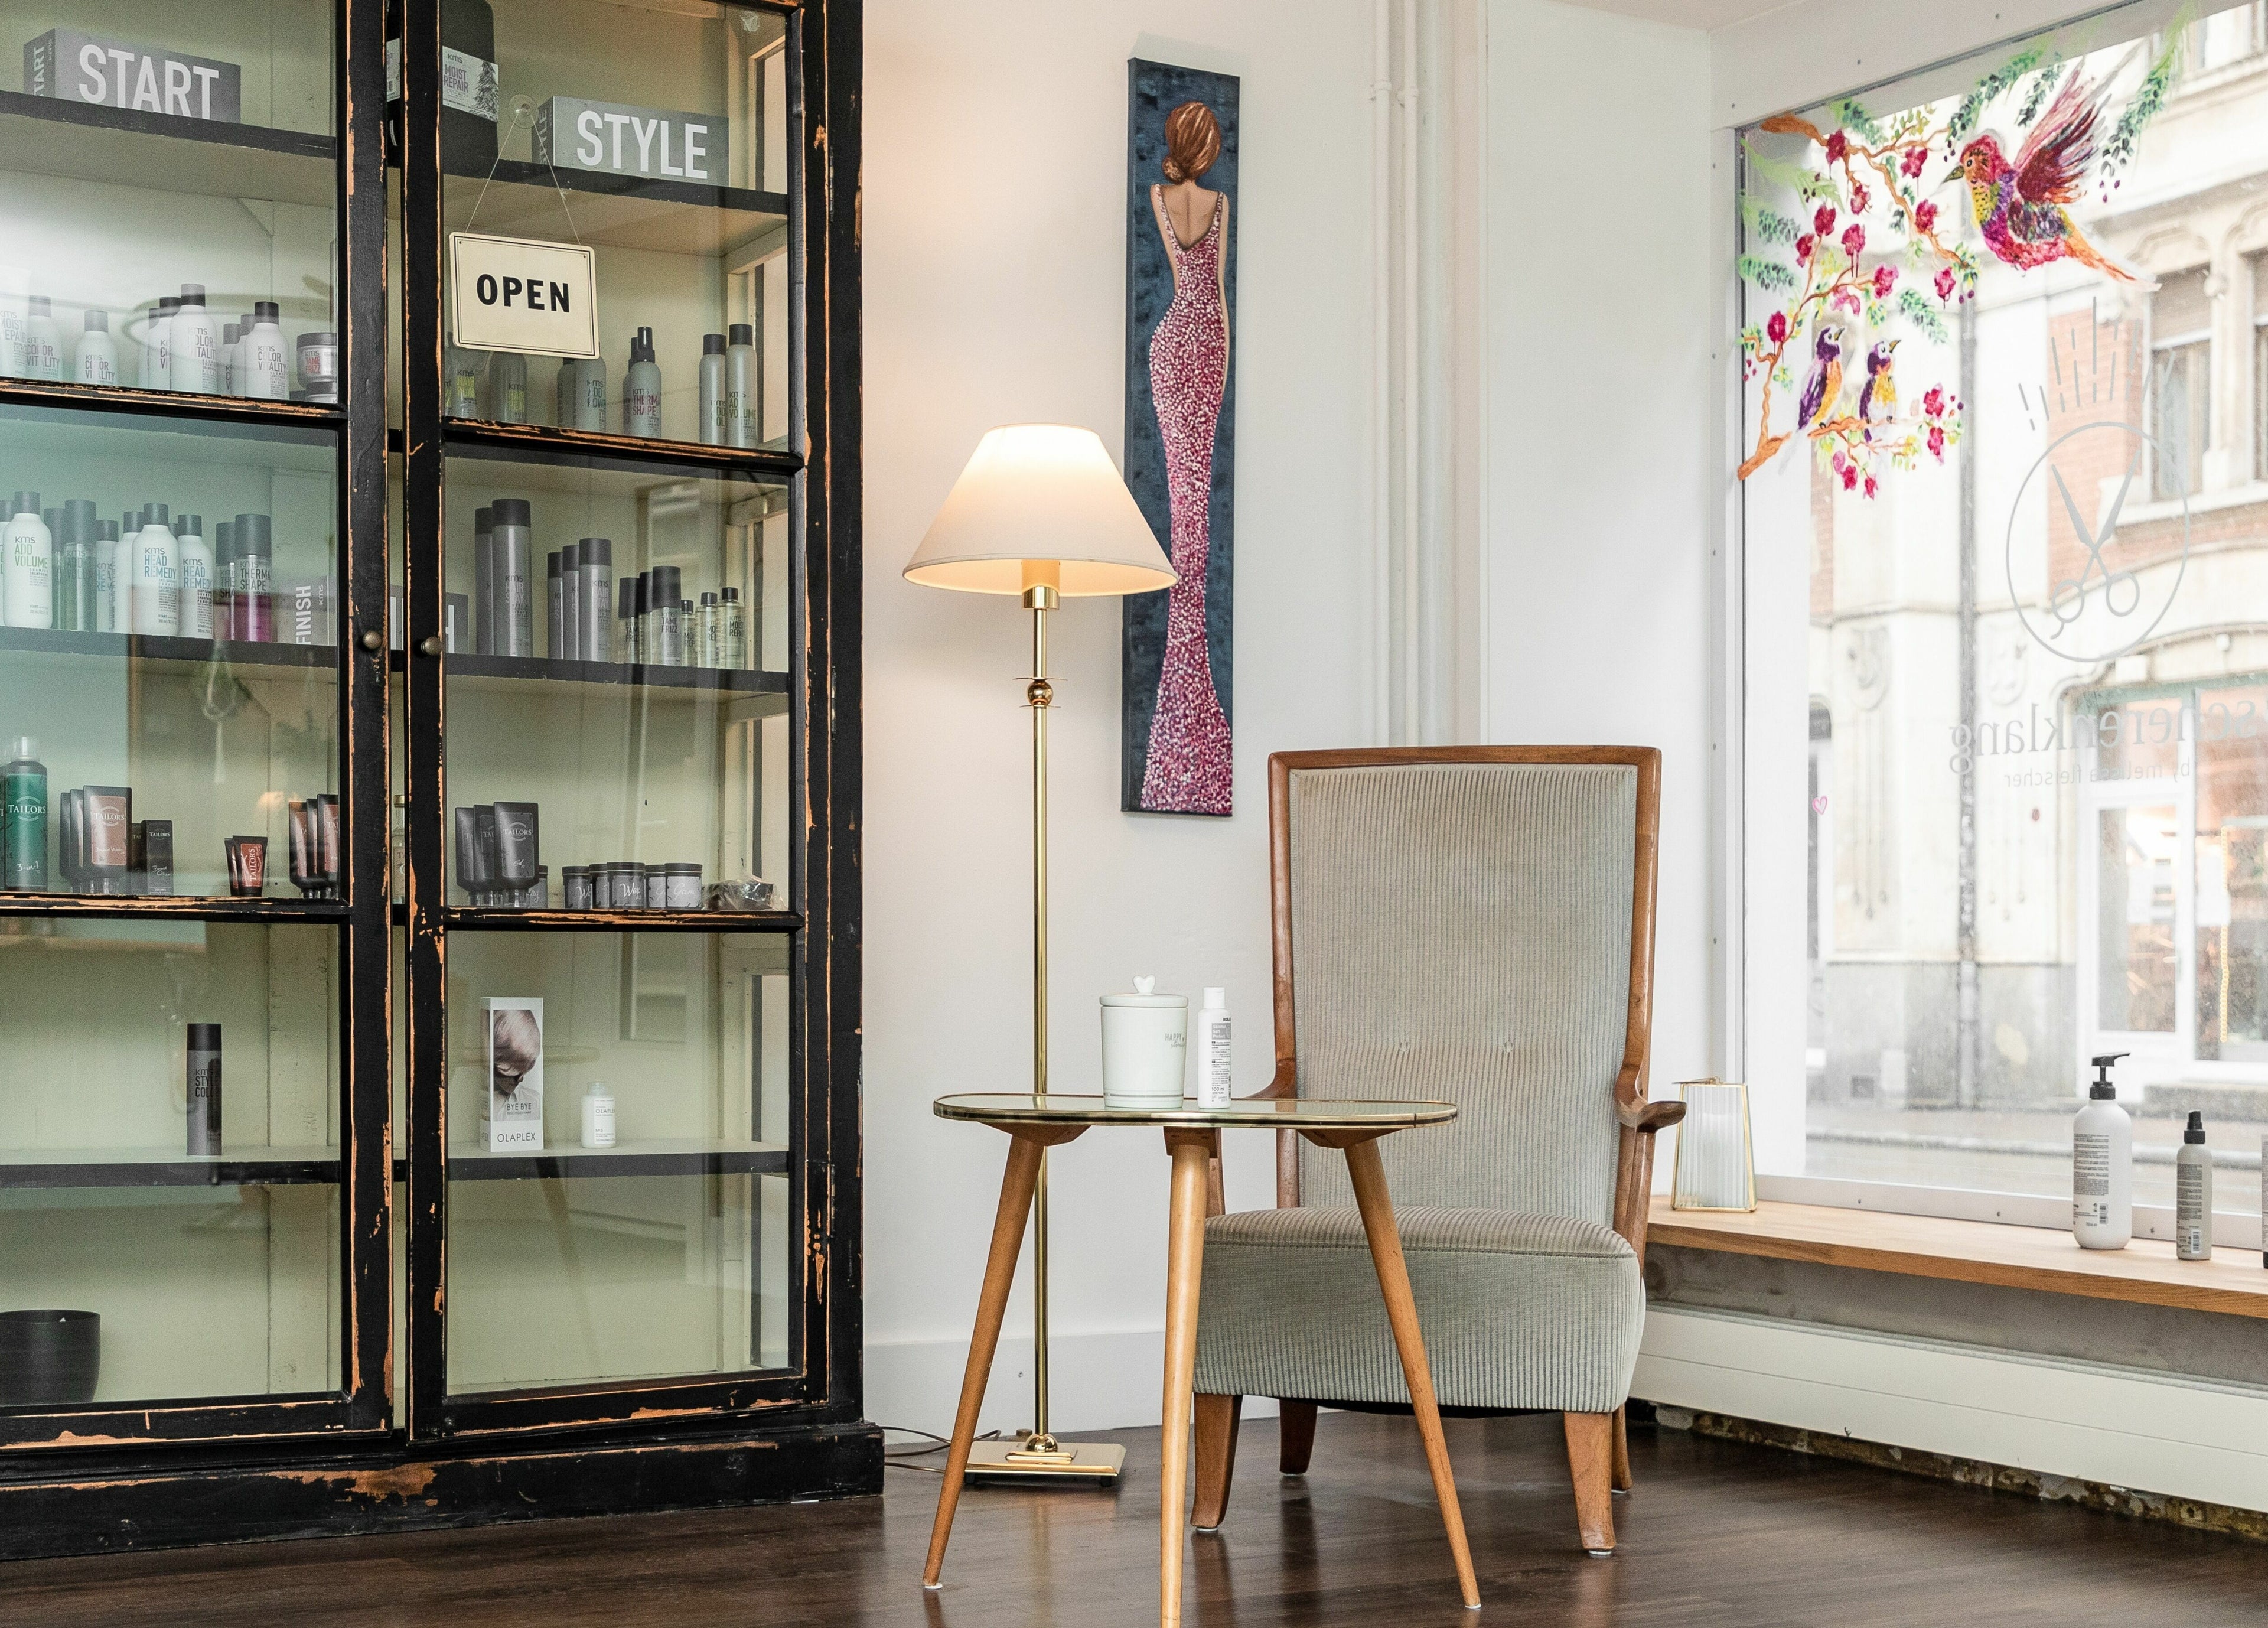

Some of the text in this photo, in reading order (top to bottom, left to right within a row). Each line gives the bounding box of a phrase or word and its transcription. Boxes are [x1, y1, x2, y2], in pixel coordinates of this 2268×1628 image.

[445, 64, 467, 80] MOIST
[79, 44, 219, 120] START
[444, 76, 468, 93] REPAIR
[577, 110, 708, 179] STYLE
[477, 274, 569, 312] OPEN
[4, 330, 27, 343] EPAIR
[258, 352, 281, 363] CLOR
[15, 543, 32, 555] ADD
[15, 555, 48, 569] VOLUME
[145, 555, 167, 566] HEAD
[145, 566, 177, 579] REMEDY
[184, 565, 206, 578] HEAD
[240, 579, 266, 591] SHAPE
[296, 585, 312, 645] FINISH
[8, 805, 46, 814] TAILORS
[93, 812, 125, 820] TAILORS
[620, 883, 641, 898] Wax
[195, 1076, 214, 1087] STYL
[520, 1102, 532, 1111] BYE
[497, 1132, 536, 1143] OLAPLEX
